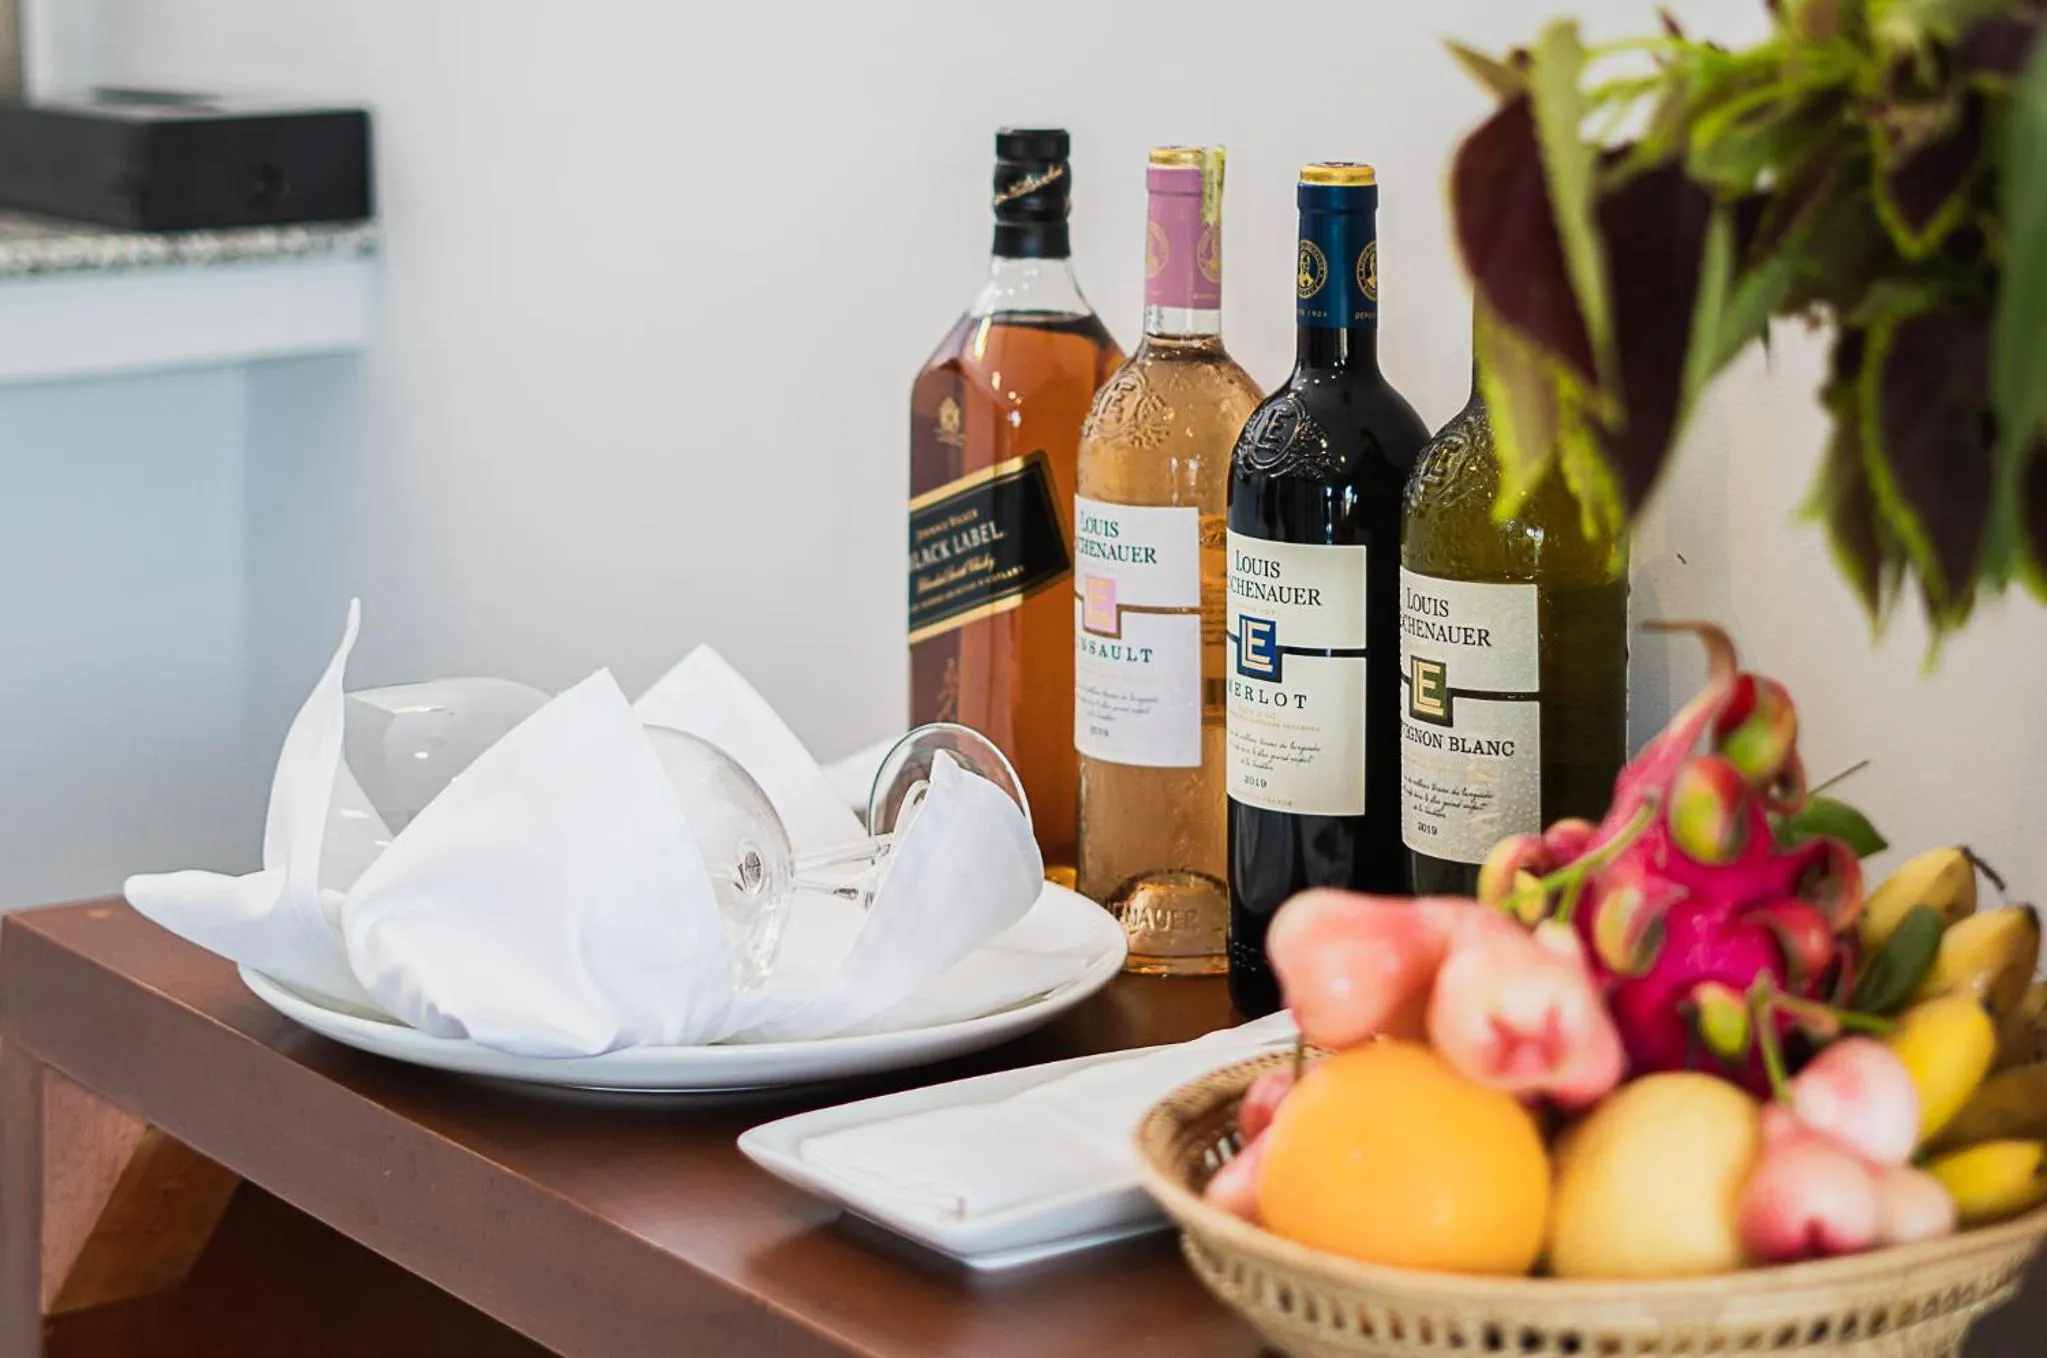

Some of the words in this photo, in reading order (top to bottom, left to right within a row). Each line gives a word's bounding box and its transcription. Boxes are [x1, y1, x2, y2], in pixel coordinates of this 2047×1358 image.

[1081, 510, 1119, 537] LOUIS
[952, 520, 1004, 555] LABEL
[1236, 549, 1280, 578] LOUIS
[1406, 587, 1449, 618] LOUIS
[1447, 736, 1515, 757] BLANC
[1243, 774, 1268, 789] 2019
[1416, 820, 1438, 836] 2019
